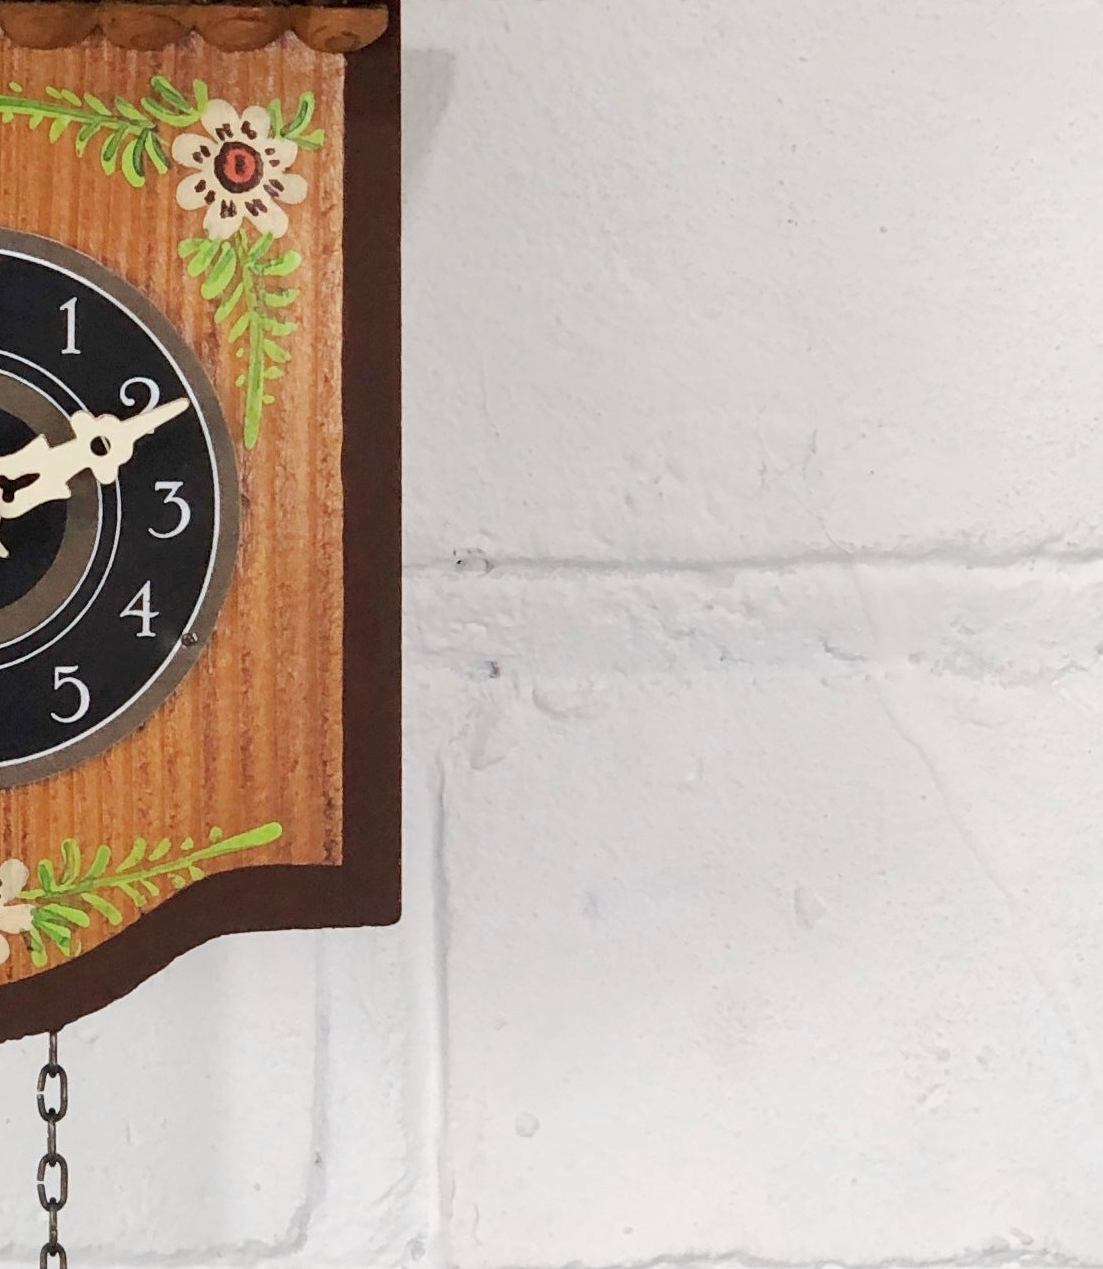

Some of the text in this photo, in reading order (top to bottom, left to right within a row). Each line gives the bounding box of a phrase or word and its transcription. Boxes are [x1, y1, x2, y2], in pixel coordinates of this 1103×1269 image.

[59, 297, 81, 355] 1
[147, 481, 191, 538] 3
[120, 581, 159, 637] 4
[51, 666, 90, 723] 5
